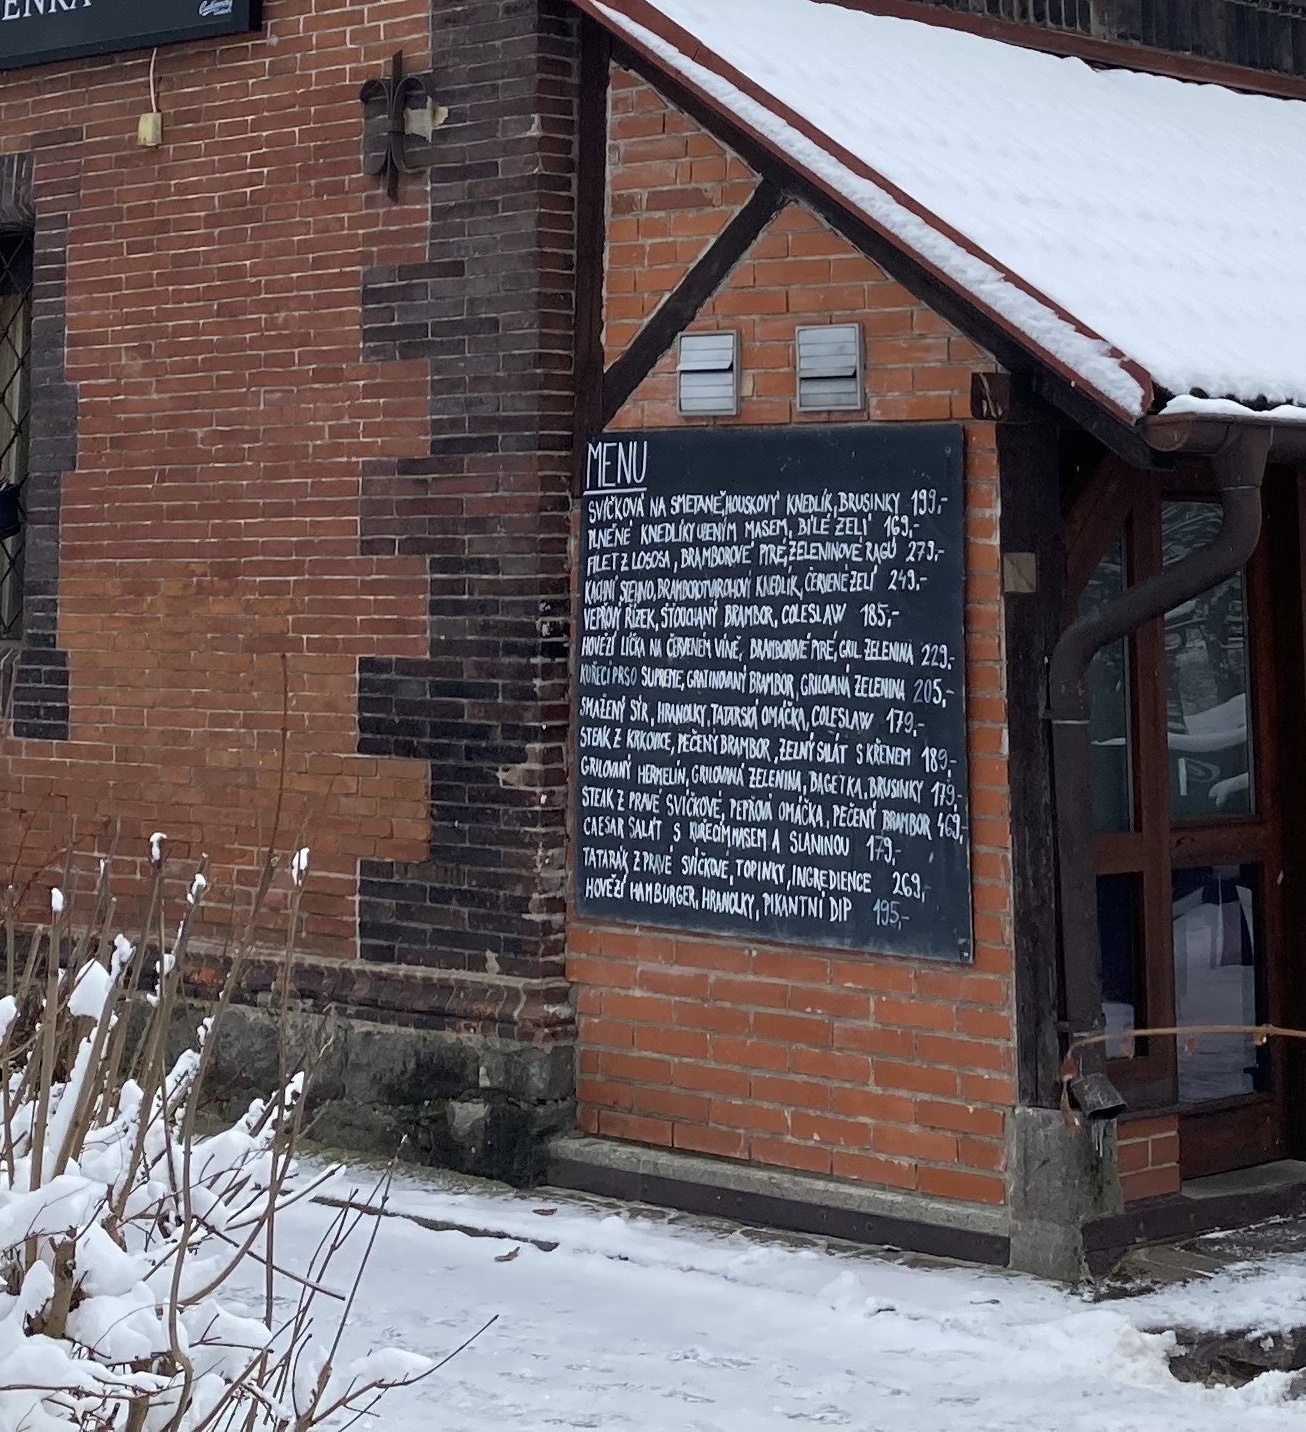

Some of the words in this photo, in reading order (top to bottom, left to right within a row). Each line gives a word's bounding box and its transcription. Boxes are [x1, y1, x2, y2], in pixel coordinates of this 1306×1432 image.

[586, 441, 647, 489] MENU
[588, 493, 645, 524] SVÍČKOVÁ
[650, 496, 667, 518] NA
[786, 488, 837, 518] KNEDLÍK,
[838, 492, 900, 517] BRUSINKY
[910, 489, 948, 516] 199,-
[640, 518, 696, 545] KNEDLÍKY
[745, 518, 793, 539] MASEM,
[798, 513, 831, 536] BÍLÉ
[883, 515, 920, 538] 169,-
[586, 548, 619, 577] FILET
[680, 541, 755, 570] BRAMBOROVÉ
[905, 541, 945, 562] 279,-
[887, 569, 928, 591] 249,-
[724, 604, 778, 628] BRAMBOR,
[781, 602, 847, 625] COLESLAW
[859, 602, 900, 628] 185,-
[649, 638, 663, 659] NA
[864, 638, 914, 666] ZELENINA
[612, 664, 638, 687] PRSO
[641, 665, 685, 691] SUPREME,
[854, 674, 905, 701] ZELENINA
[913, 678, 955, 708] 205,-
[811, 705, 875, 731] COLESLAW
[886, 707, 925, 737] 179,-
[579, 725, 612, 749] STEAK
[626, 728, 675, 756] KRKOVICE,
[677, 728, 719, 754] PEČENÝ
[856, 743, 863, 765] S
[868, 775, 924, 804] BRUSINKY
[581, 785, 615, 810] STEAK
[628, 788, 663, 813] PRAVÉ
[832, 800, 877, 830] PEČENÝ
[881, 809, 933, 841] BRAMBOR
[583, 816, 624, 839] CAESAR
[628, 815, 663, 841] SALÁT
[672, 821, 681, 843] S
[732, 827, 767, 852] MASEM
[772, 828, 781, 854] A
[789, 830, 850, 856] SLANINOU
[792, 865, 872, 893] INGREDIENCE
[762, 890, 825, 919] PIKANTNÍ
[829, 896, 853, 922] DIP
